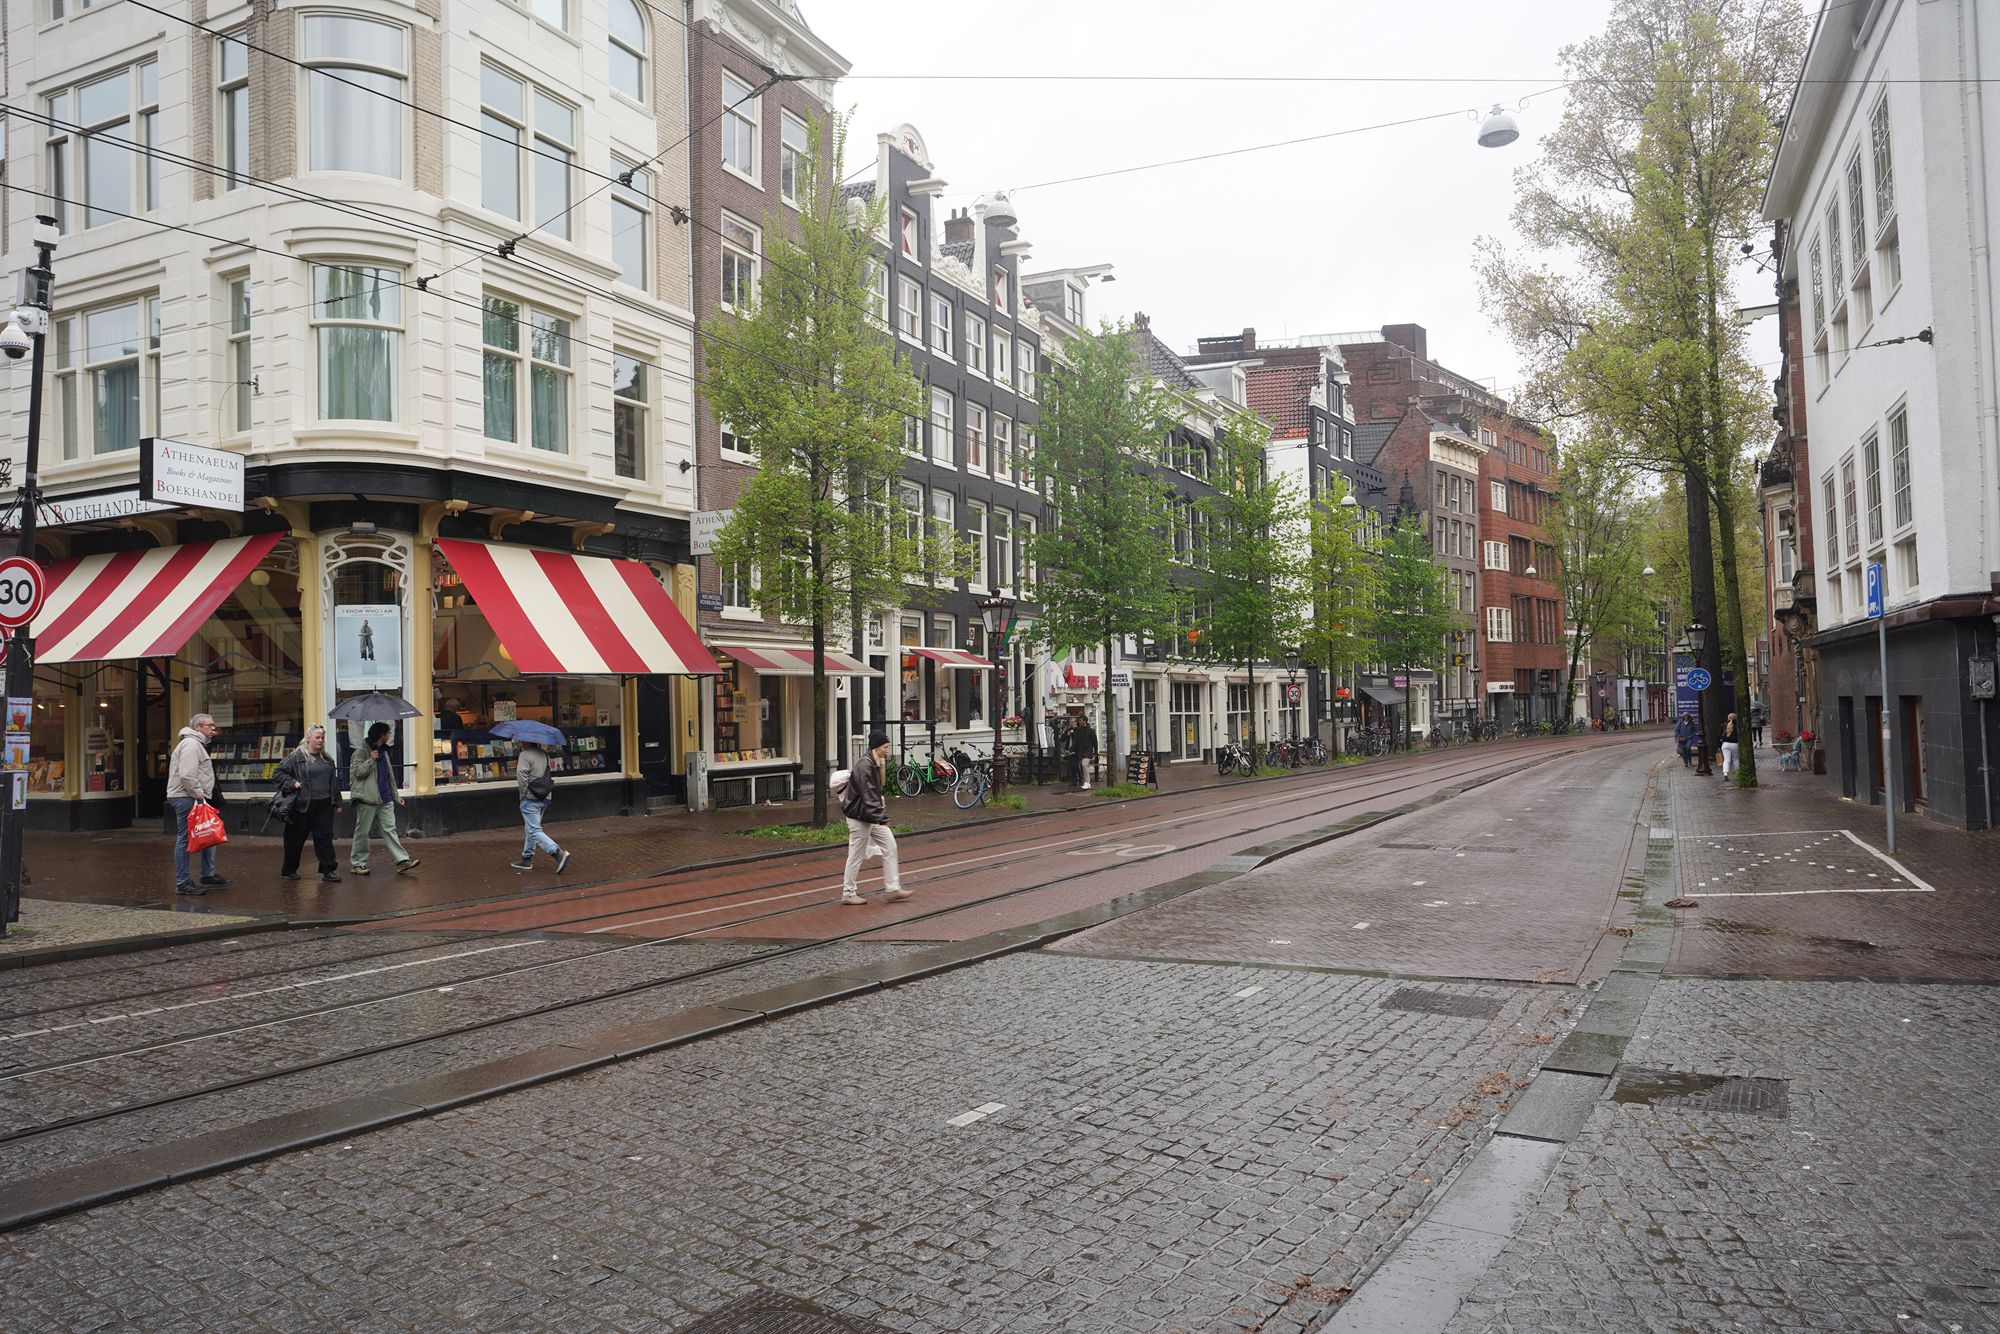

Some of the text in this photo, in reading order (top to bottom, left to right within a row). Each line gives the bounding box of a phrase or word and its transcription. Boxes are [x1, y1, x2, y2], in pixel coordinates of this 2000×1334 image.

[161, 447, 238, 470] ATHENAEUM
[166, 467, 186, 476] Books
[197, 473, 232, 484] Magazines
[157, 480, 240, 503] BOEKHANDEL
[53, 498, 151, 524] BOEKHANDEL
[695, 514, 732, 525] ATHENE
[0, 579, 33, 605] 30
[1869, 570, 1876, 597] P
